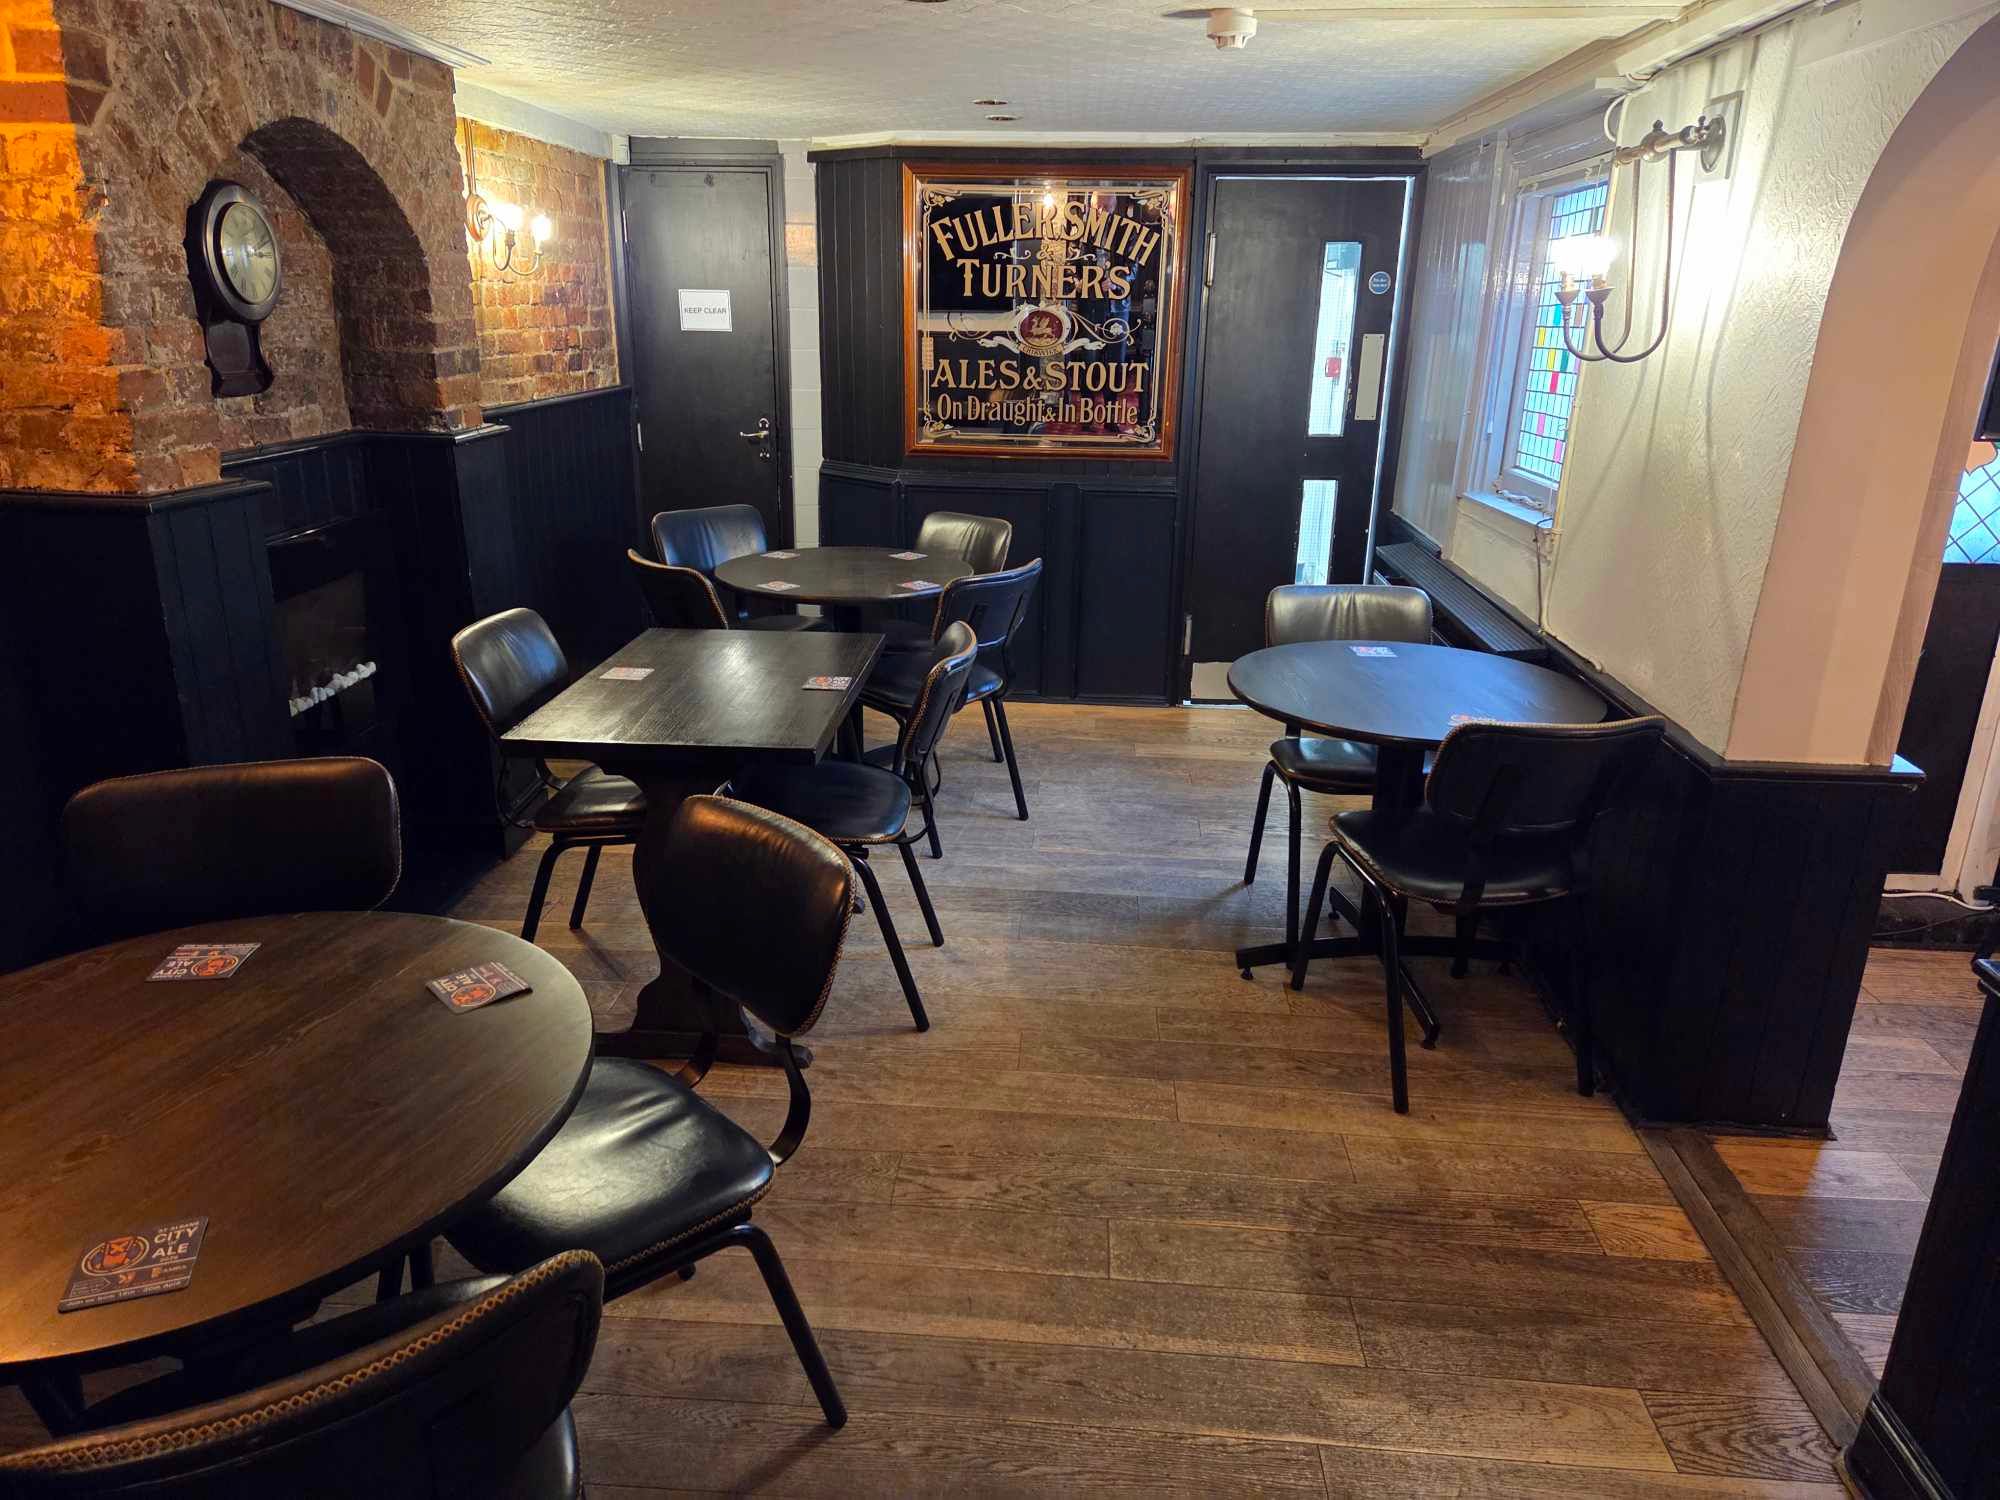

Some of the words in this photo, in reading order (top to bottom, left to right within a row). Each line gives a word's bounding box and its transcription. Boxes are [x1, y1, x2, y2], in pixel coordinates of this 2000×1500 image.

[1061, 200, 1160, 267] SMITH
[931, 359, 1021, 390] ALES
[1022, 366, 1043, 390] &
[1045, 361, 1149, 393] STOUT
[937, 393, 963, 421] On
[967, 395, 1045, 426] Draught
[1046, 407, 1057, 423] &
[1058, 399, 1076, 423] In
[1079, 397, 1138, 425] Bottle
[151, 1242, 190, 1259] ALE
[154, 1226, 199, 1244] CITY
